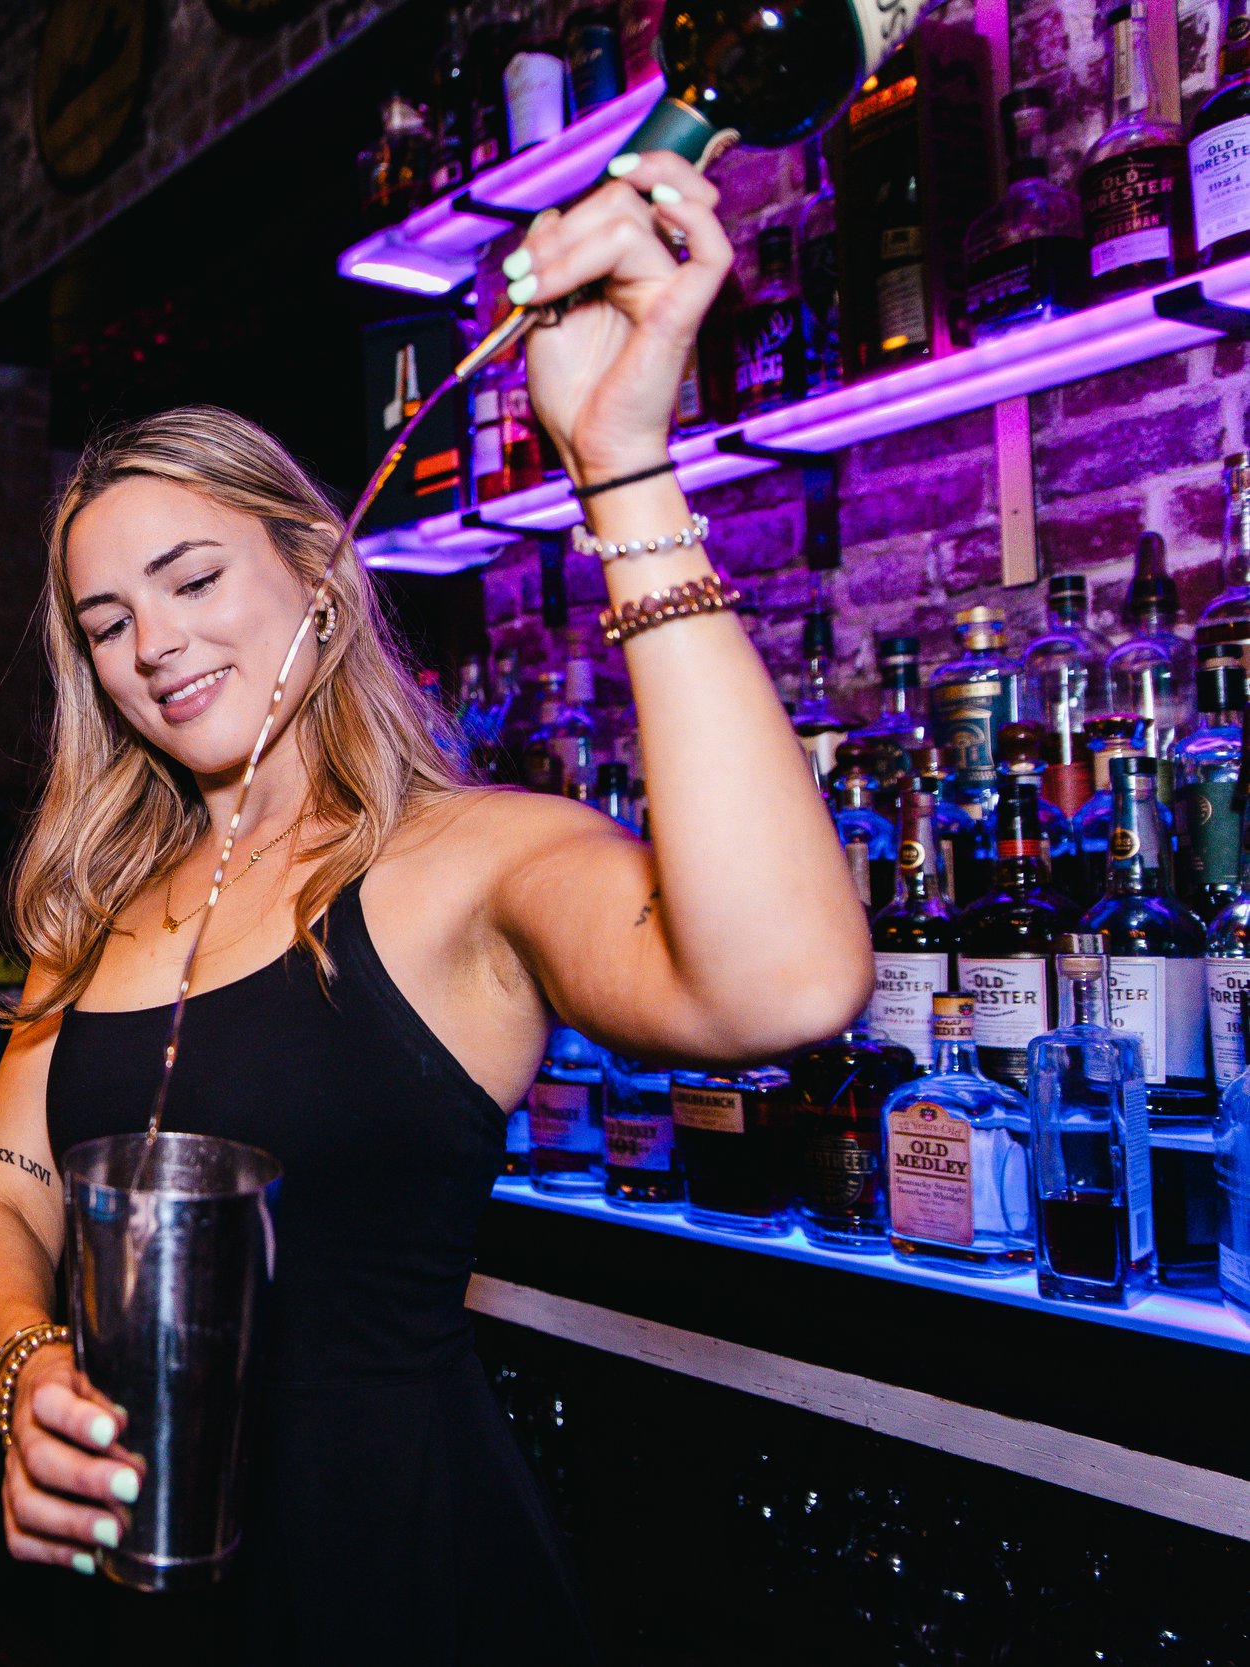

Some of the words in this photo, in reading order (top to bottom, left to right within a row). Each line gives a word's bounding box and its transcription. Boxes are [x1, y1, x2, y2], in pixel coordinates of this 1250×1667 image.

[1207, 139, 1235, 156] OLD
[1193, 145, 1250, 175] FORESTE
[1101, 169, 1139, 190] OLD
[884, 969, 908, 980] OLD
[974, 974, 1004, 989] OLD
[876, 980, 934, 992] ORESTER
[973, 990, 1036, 1005] RESTER
[911, 1140, 949, 1157] OLD
[19, 1154, 51, 1187] LXVI
[895, 1153, 968, 1175] MEDLEY
